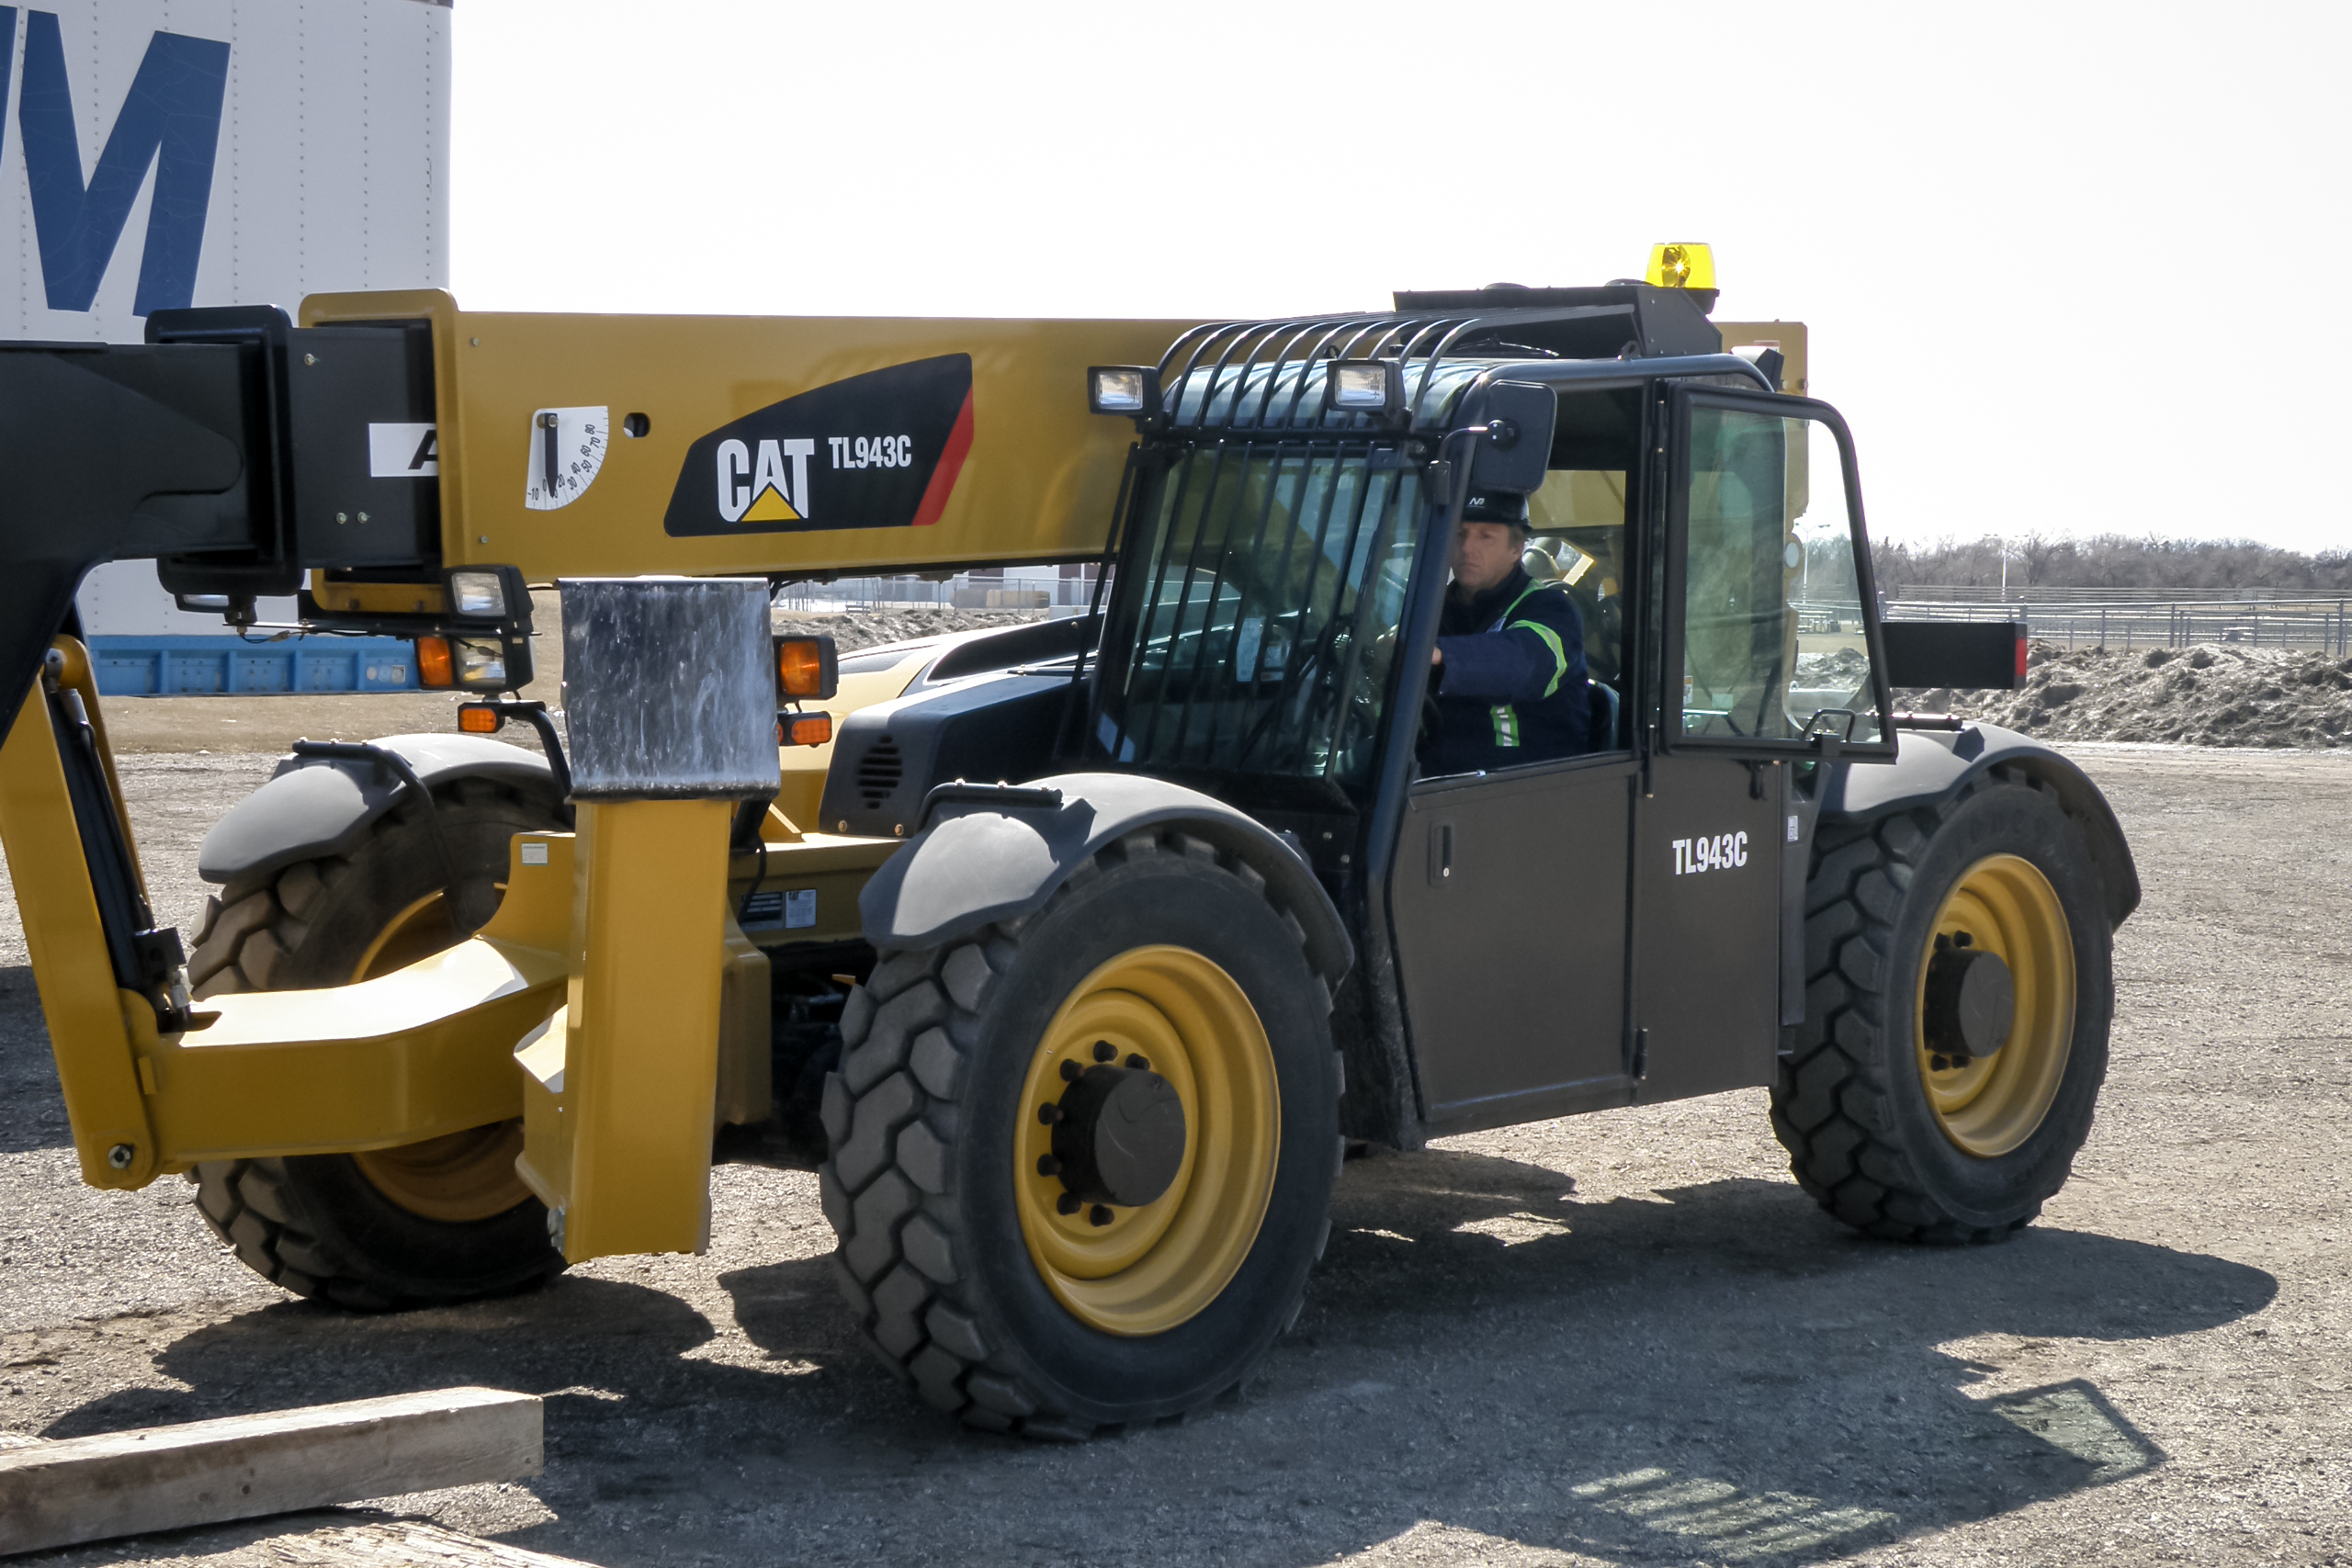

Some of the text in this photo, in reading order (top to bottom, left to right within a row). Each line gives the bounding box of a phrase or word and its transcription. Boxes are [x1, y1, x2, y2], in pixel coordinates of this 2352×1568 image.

[0, 6, 231, 318] M
[584, 423, 595, 434] 80
[589, 436, 601, 448] 70
[580, 445, 592, 457] 60
[581, 459, 593, 473] 50
[717, 434, 912, 522] CAT TL943C
[1672, 830, 1748, 875] TL943C
